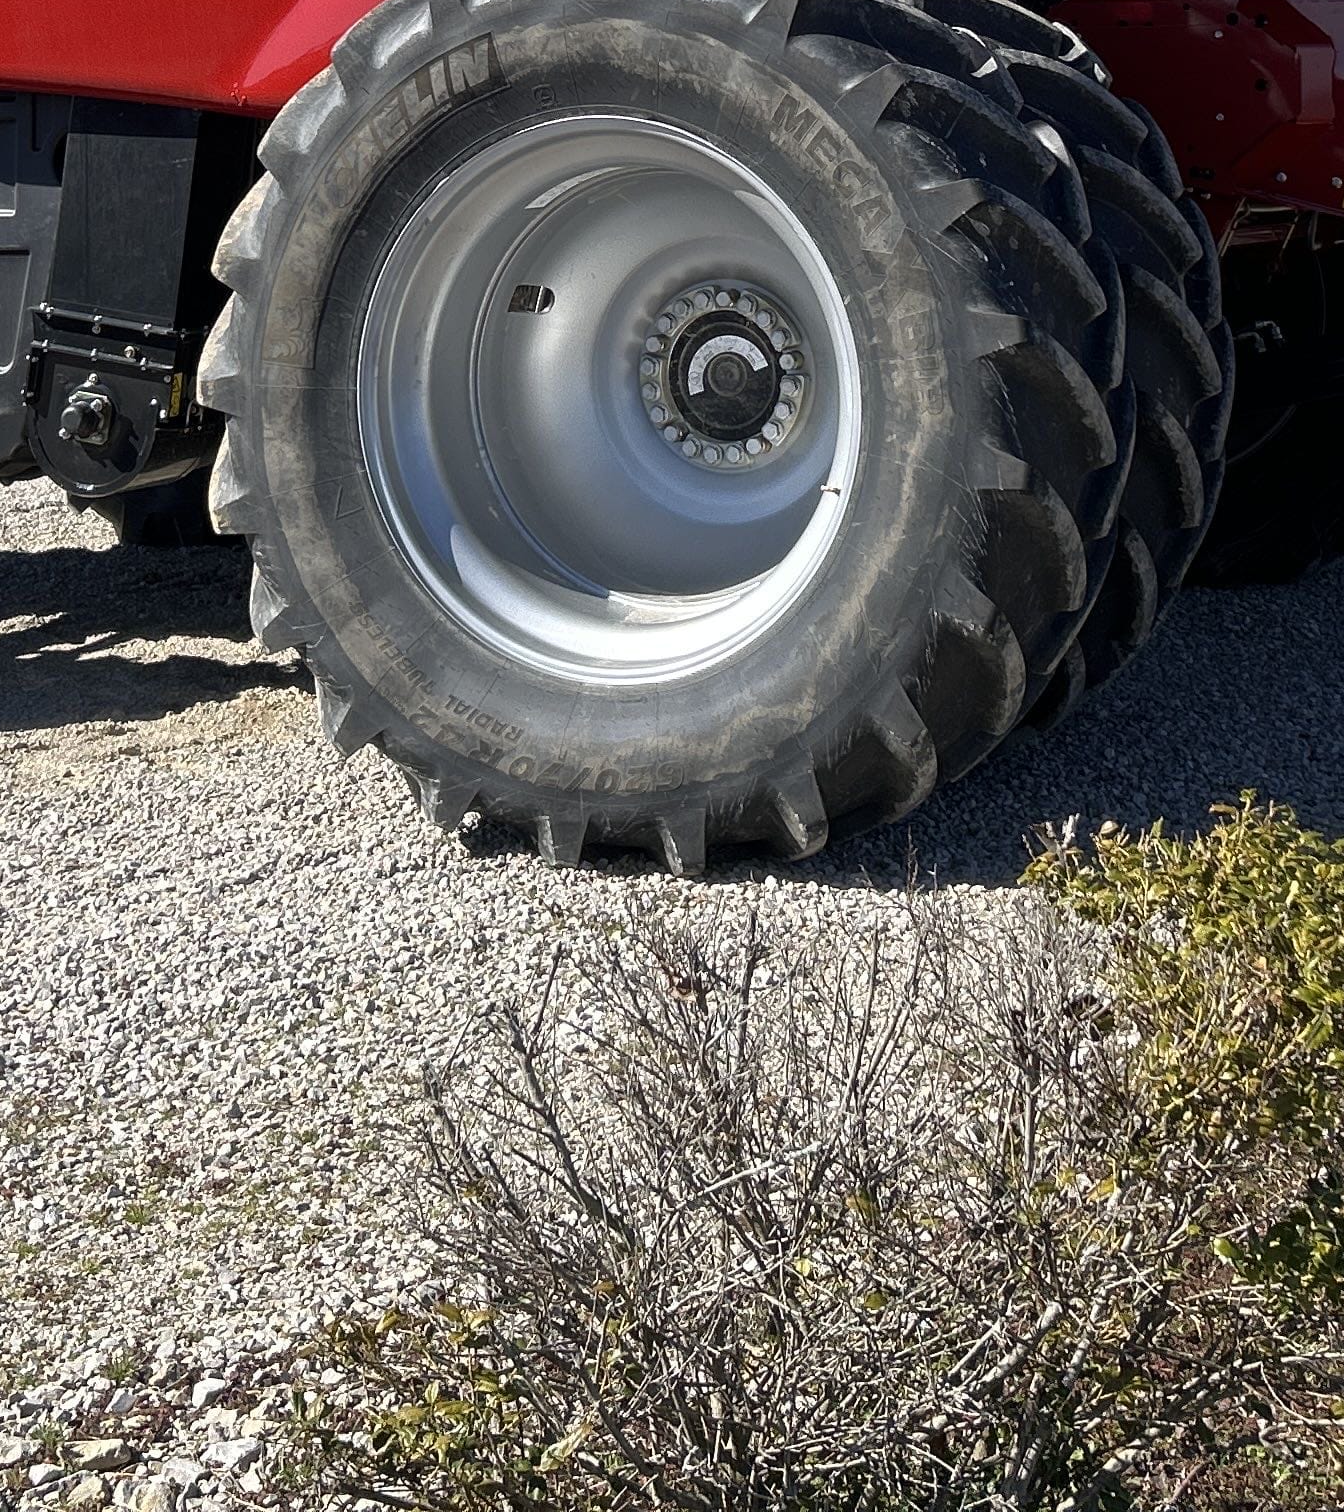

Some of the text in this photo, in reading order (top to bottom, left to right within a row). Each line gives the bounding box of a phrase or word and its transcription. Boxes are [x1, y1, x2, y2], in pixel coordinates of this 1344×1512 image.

[773, 93, 890, 237] MEGA
[349, 601, 525, 744] RADIAL TUBELESS
[408, 703, 683, 795] 620/70 R 42
